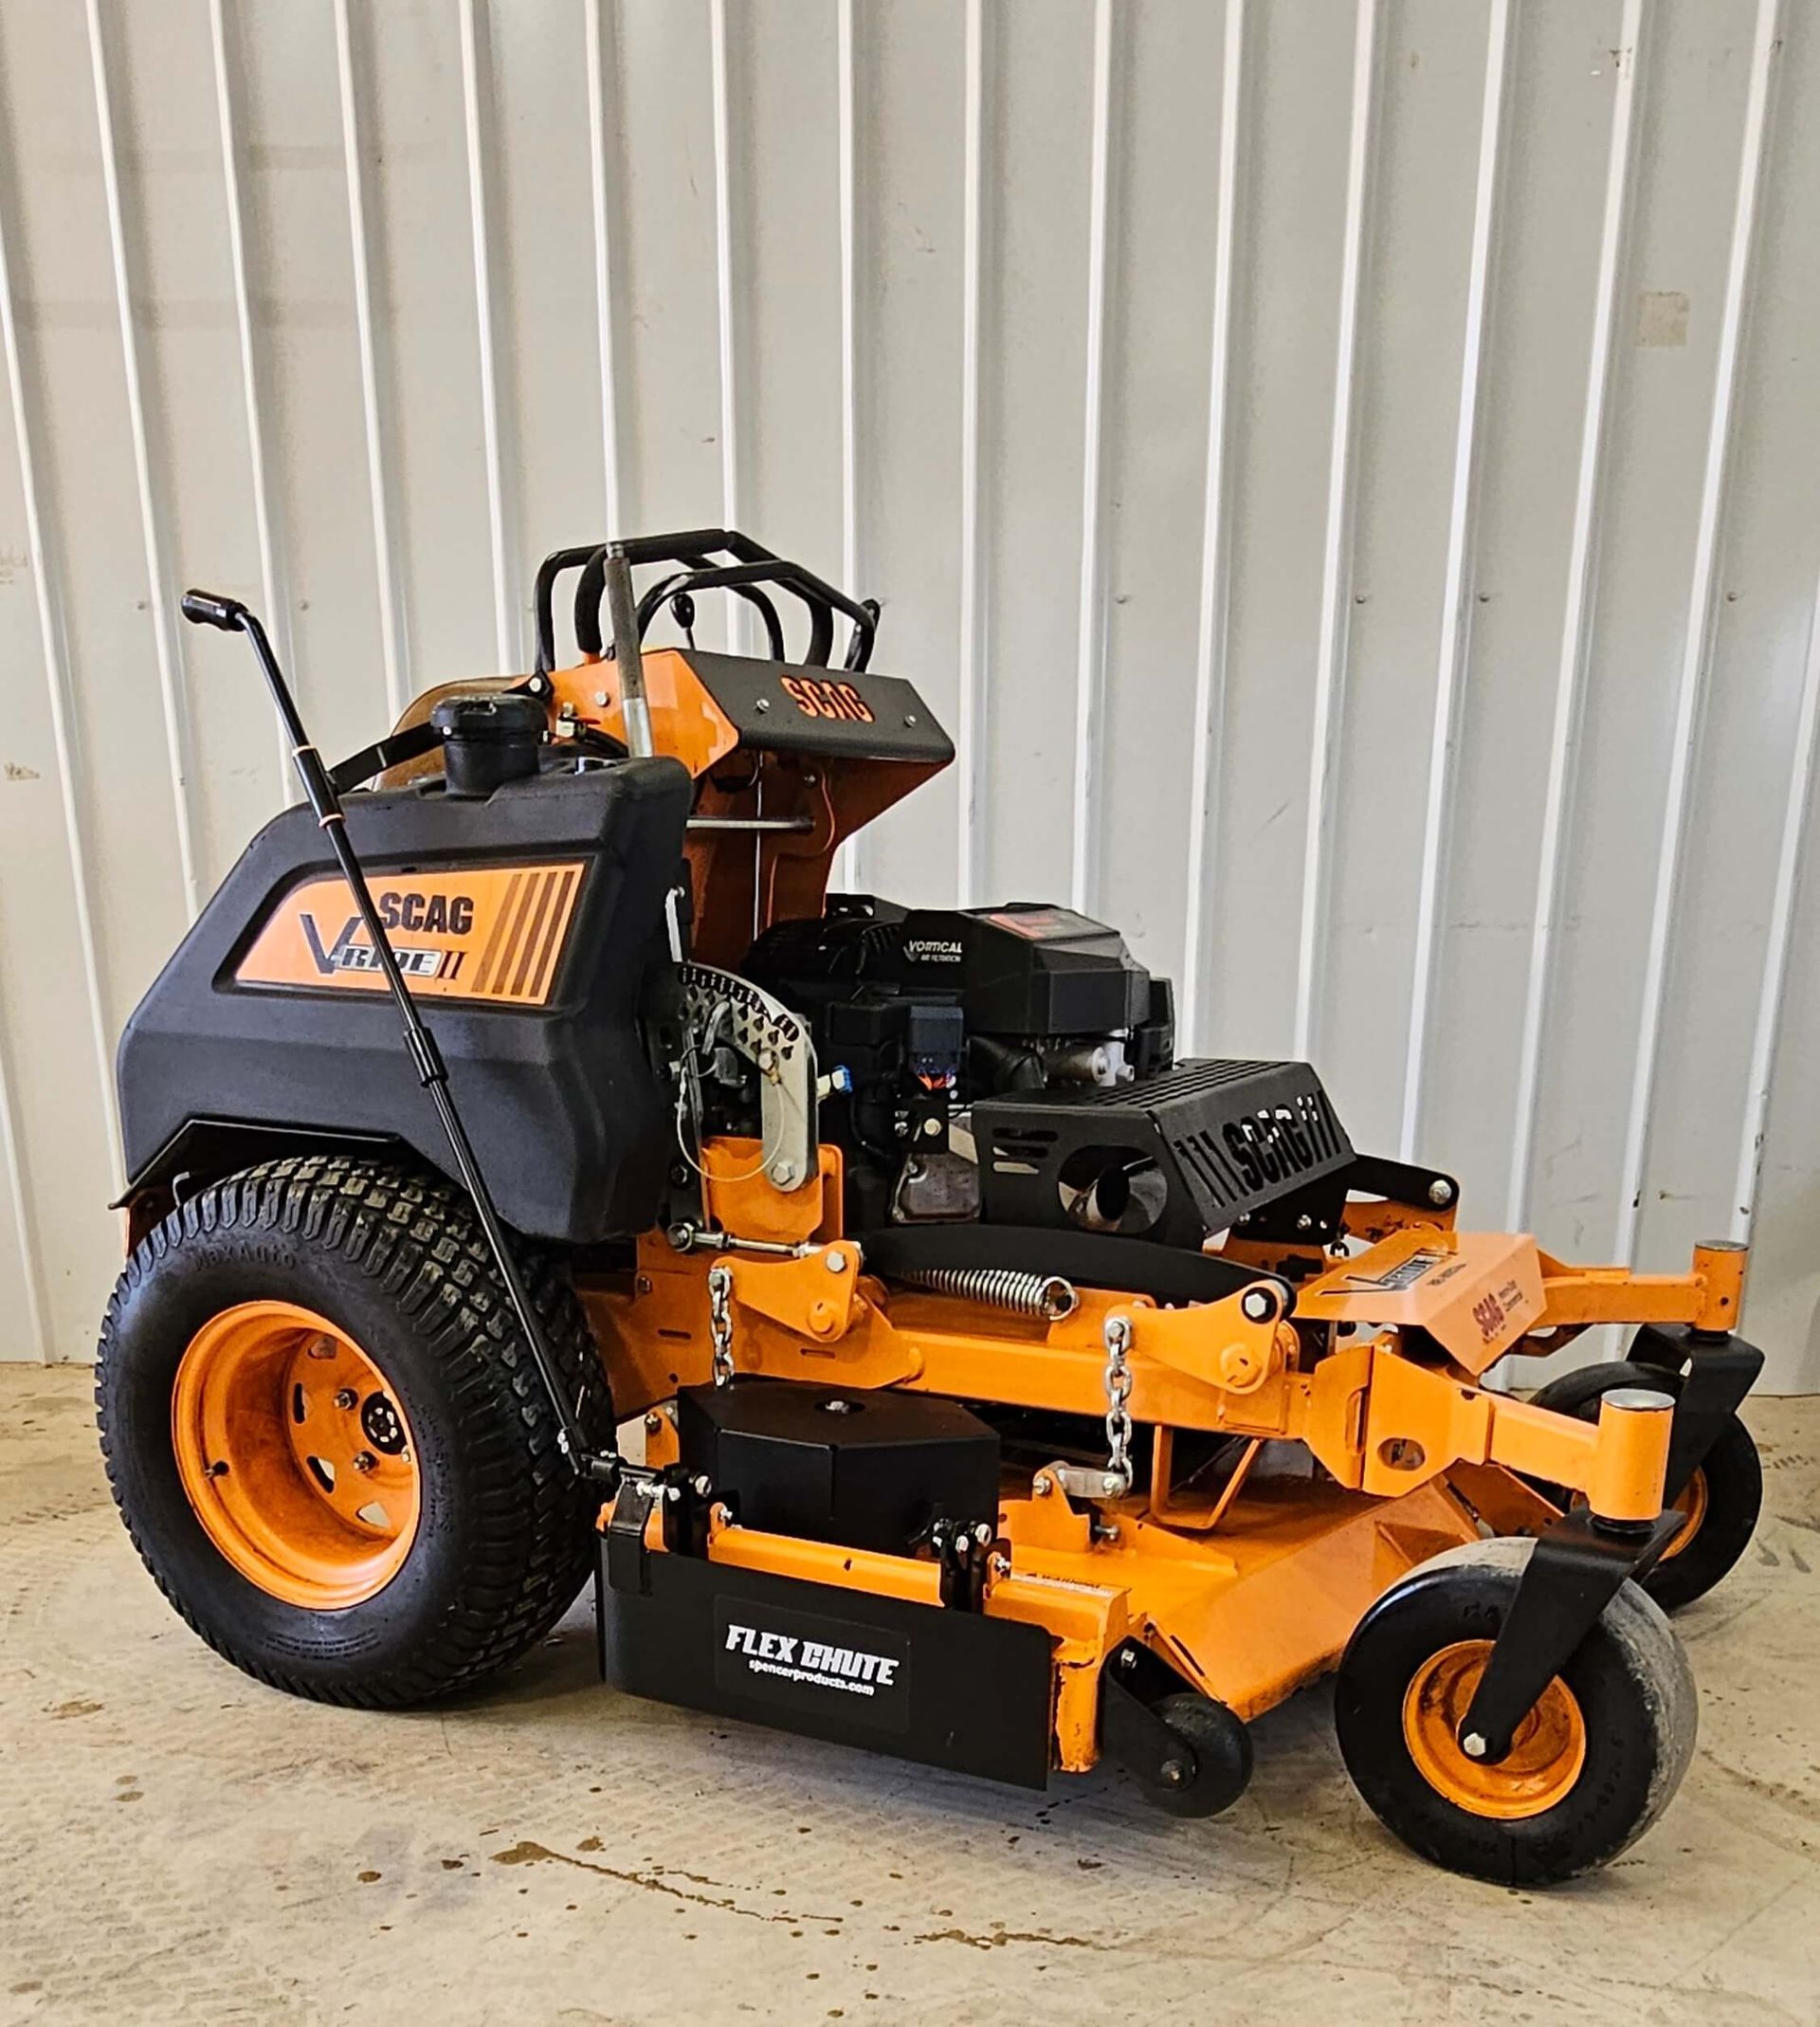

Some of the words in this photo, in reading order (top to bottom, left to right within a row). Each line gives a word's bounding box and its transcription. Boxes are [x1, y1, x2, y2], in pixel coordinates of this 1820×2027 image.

[780, 674, 876, 723] SCAG
[379, 892, 474, 935] SCAG
[908, 940, 963, 954] VORTICAL
[1222, 1103, 1315, 1192] SCAG
[725, 1624, 799, 1664] FLEX
[800, 1641, 901, 1686] CHUTE
[748, 1659, 875, 1697] spencerproducts.com
